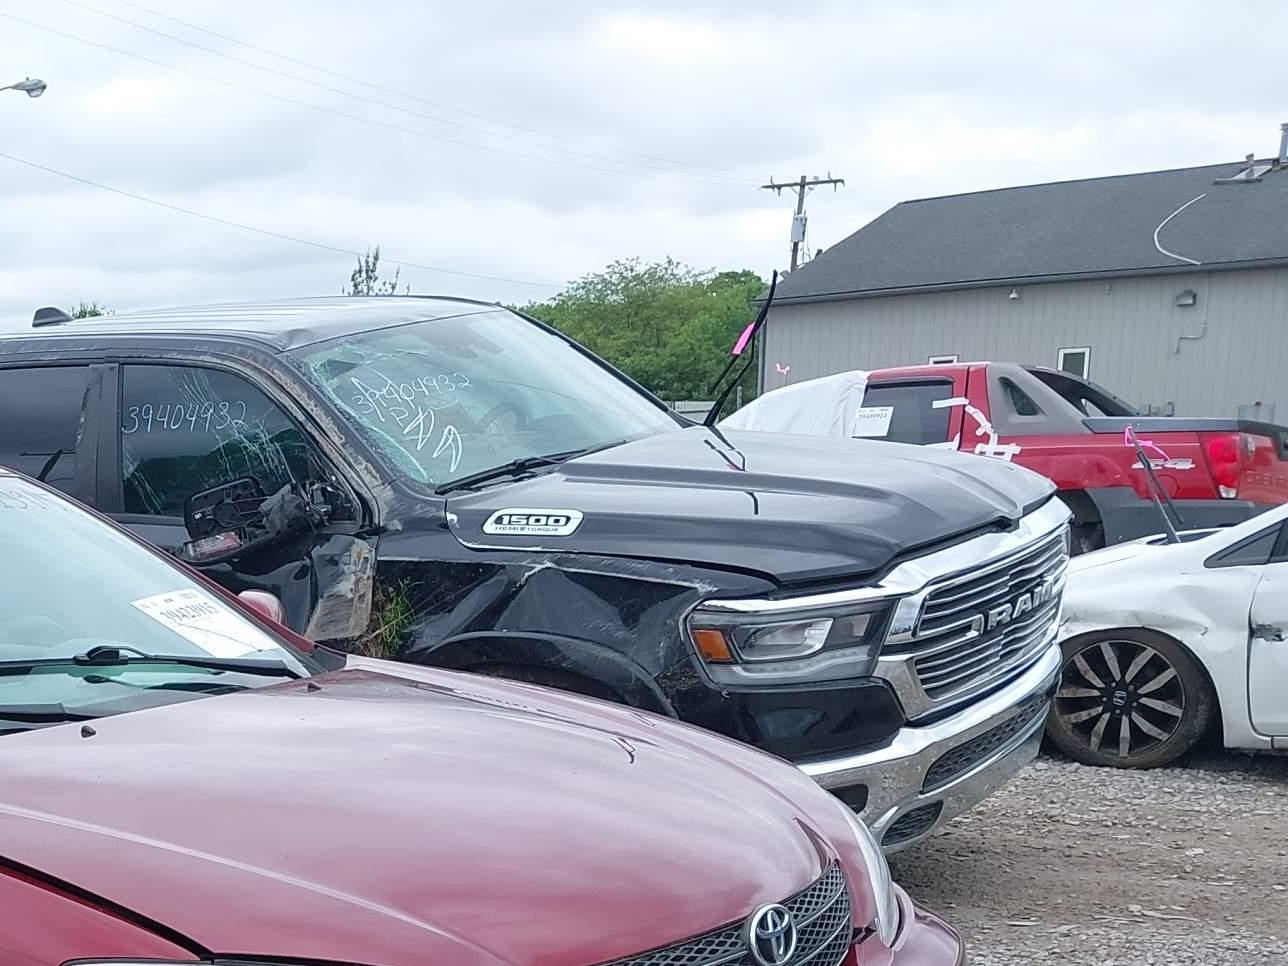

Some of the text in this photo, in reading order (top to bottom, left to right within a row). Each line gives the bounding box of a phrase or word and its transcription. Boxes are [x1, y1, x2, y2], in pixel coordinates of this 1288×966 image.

[122, 400, 249, 433] 39404932
[496, 514, 570, 526] 1500
[987, 576, 1054, 630] RAM
